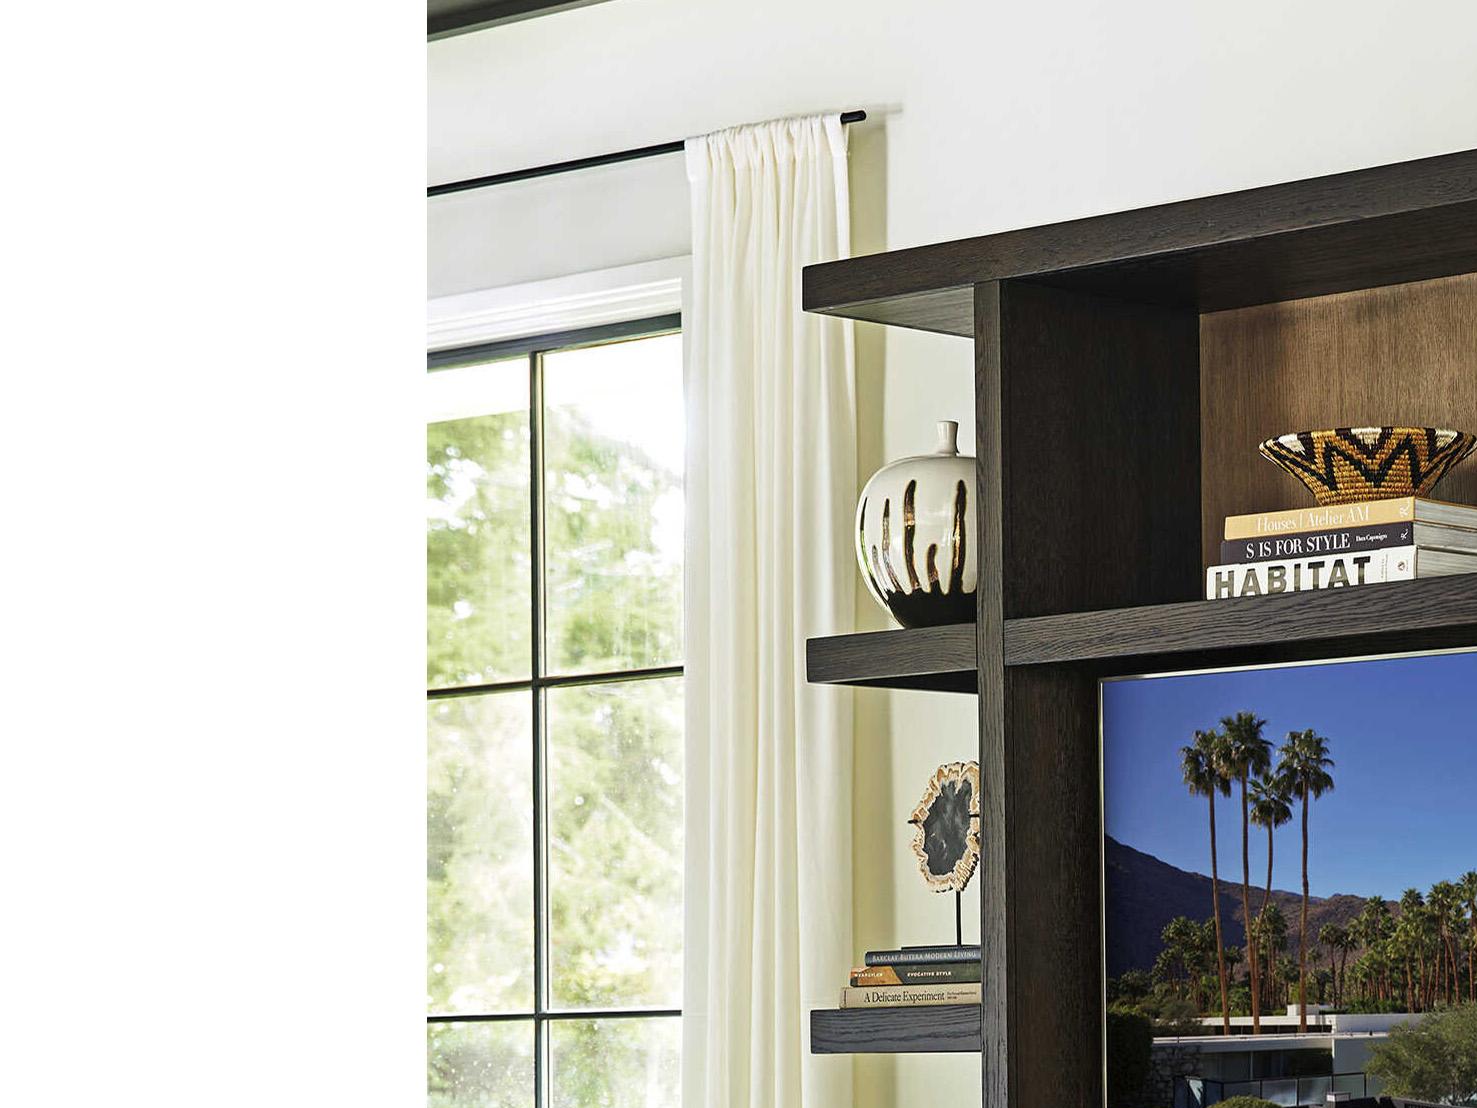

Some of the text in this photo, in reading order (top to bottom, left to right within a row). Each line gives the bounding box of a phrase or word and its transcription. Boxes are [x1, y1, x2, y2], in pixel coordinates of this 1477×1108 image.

[1245, 532, 1351, 560] S IS FOR STYLE
[1215, 555, 1371, 600] HABITAT
[864, 992, 871, 1003] A
[872, 991, 901, 1003] Delicate
[902, 990, 945, 1004] Experiment
